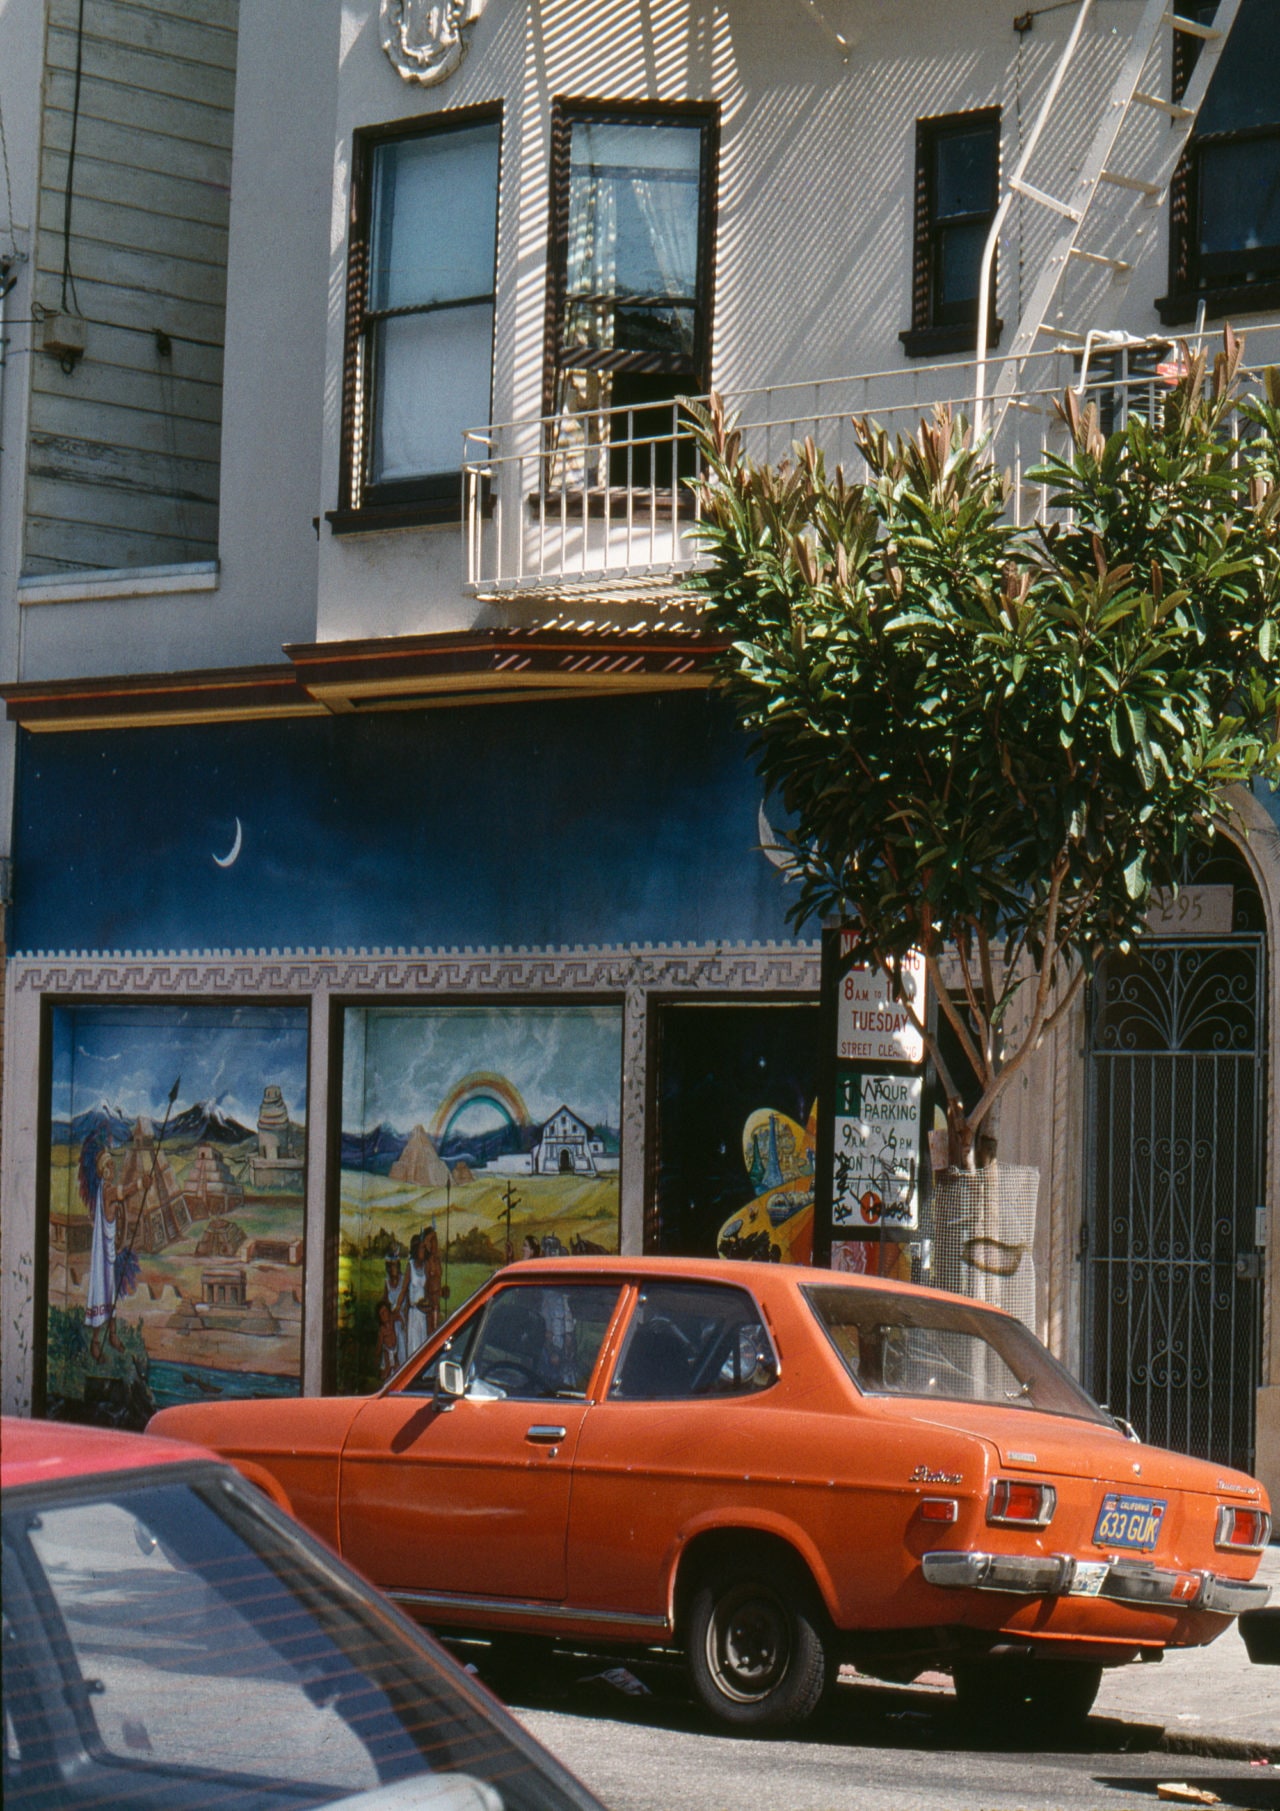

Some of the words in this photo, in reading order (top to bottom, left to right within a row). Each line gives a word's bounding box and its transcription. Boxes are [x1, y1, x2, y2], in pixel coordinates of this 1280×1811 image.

[852, 1011, 909, 1032] TUESDAY
[841, 1041, 873, 1056] STREET
[864, 1103, 918, 1121] PARKING
[1100, 1512, 1127, 1538] 633
[1127, 1515, 1159, 1543] GUK
